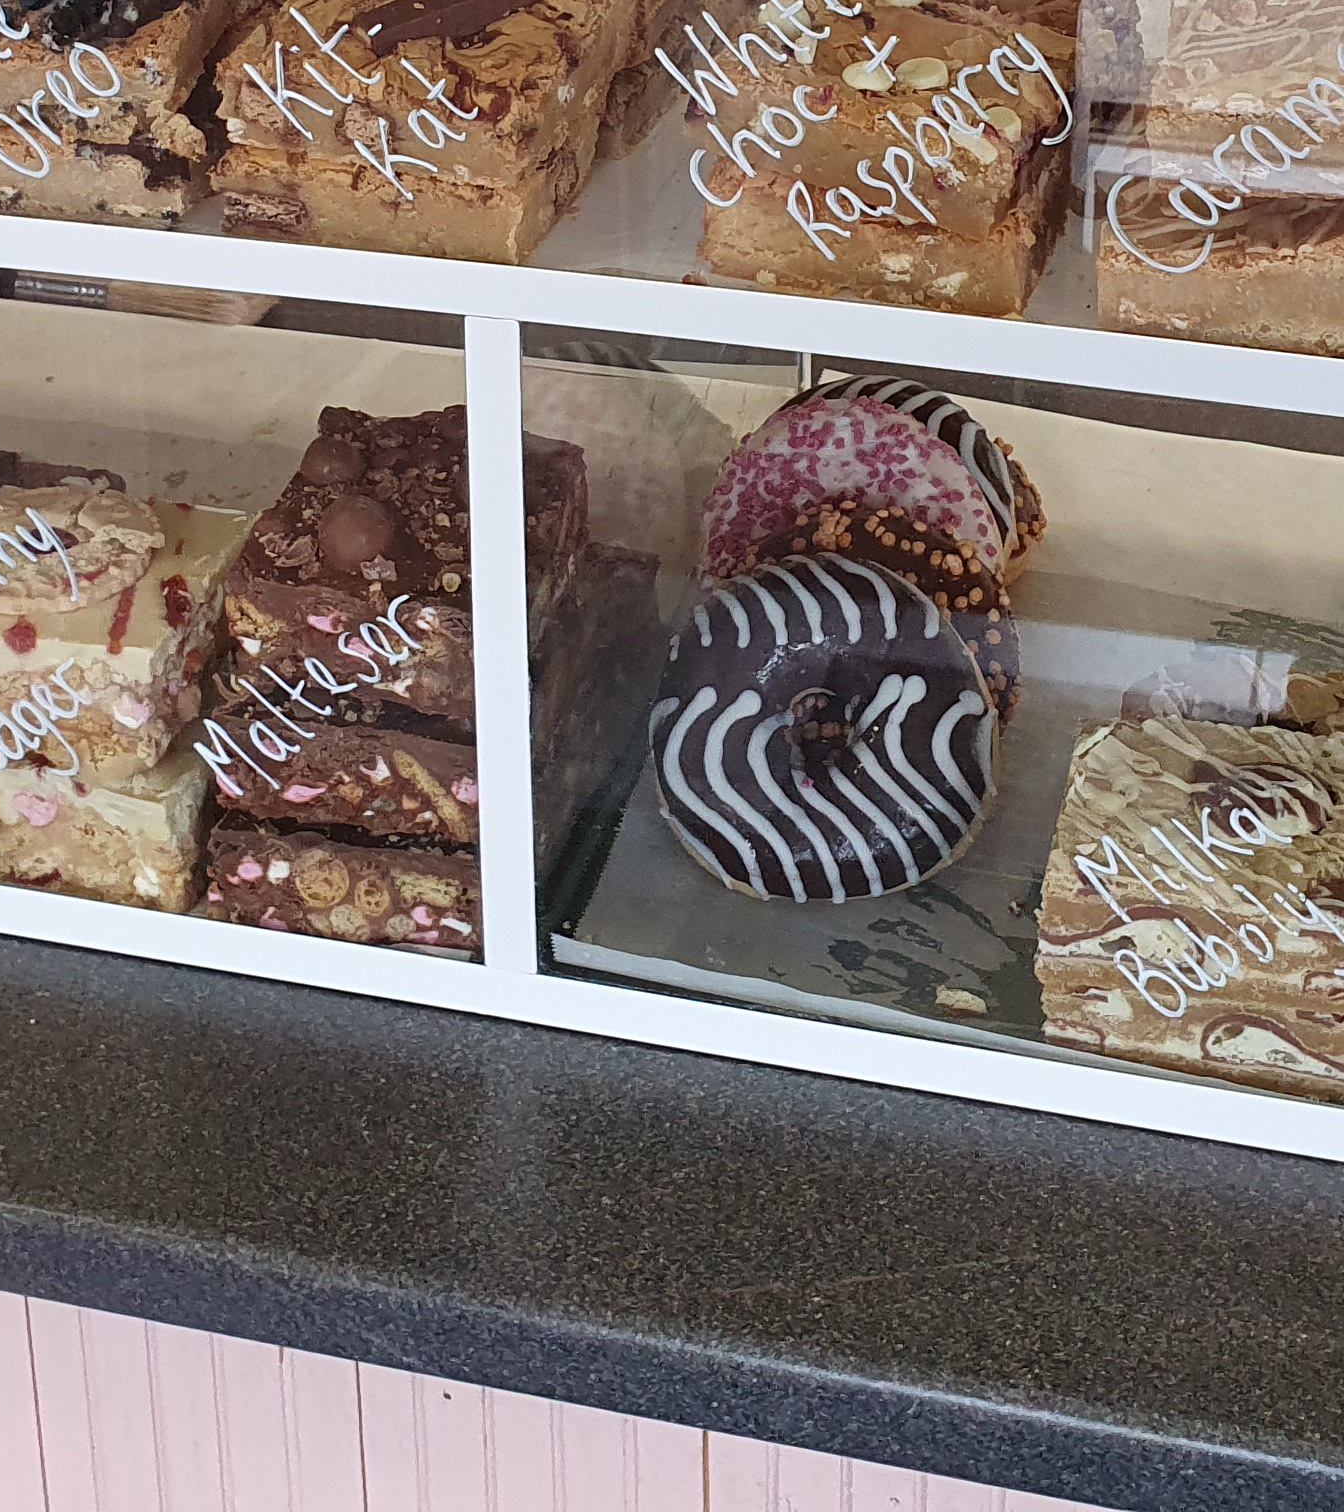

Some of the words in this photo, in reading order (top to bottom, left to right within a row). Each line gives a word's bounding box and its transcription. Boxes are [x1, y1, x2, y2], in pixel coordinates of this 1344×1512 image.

[355, 58, 479, 201] Kat
[786, 32, 1074, 261] Raspberry
[193, 594, 422, 798] Malteser
[1074, 807, 1292, 922] Milka
